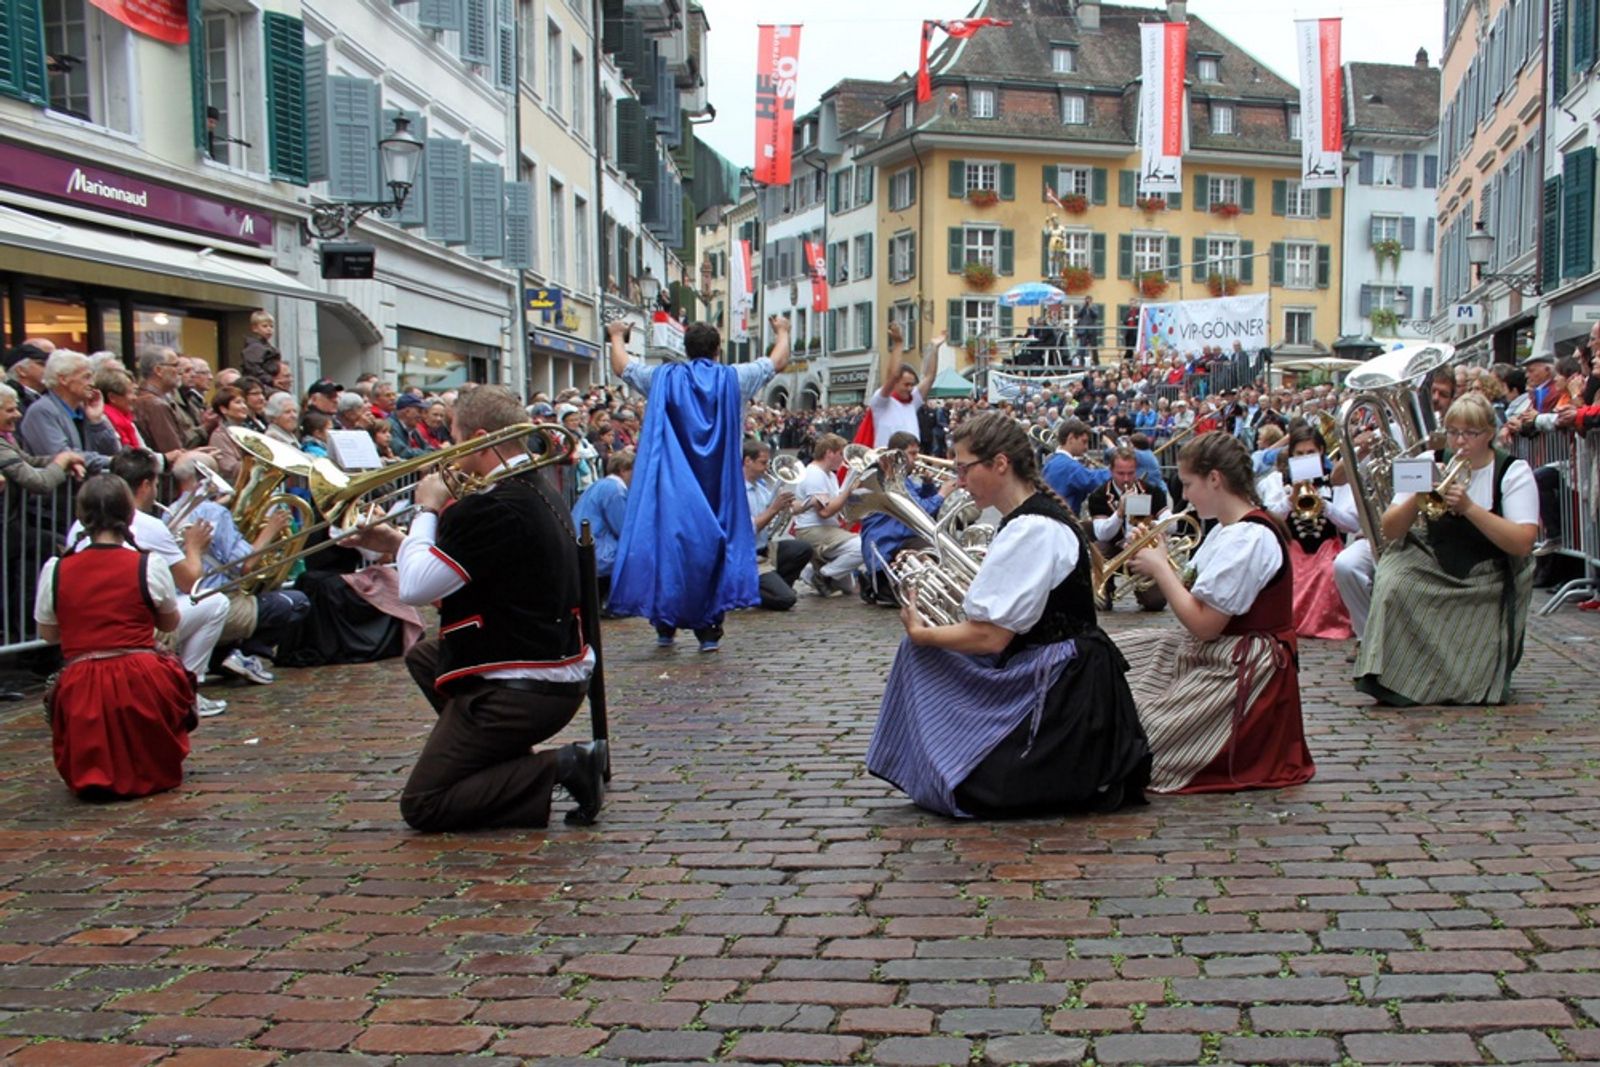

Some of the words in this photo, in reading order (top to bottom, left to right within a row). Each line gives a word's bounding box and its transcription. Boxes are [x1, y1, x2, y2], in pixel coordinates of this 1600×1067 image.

[777, 56, 799, 99] SO
[756, 74, 776, 119] HE
[66, 168, 147, 207] Marionnaud
[239, 214, 254, 236] M
[1456, 305, 1474, 318] M
[1180, 317, 1264, 340] VIP-GÖNNER
